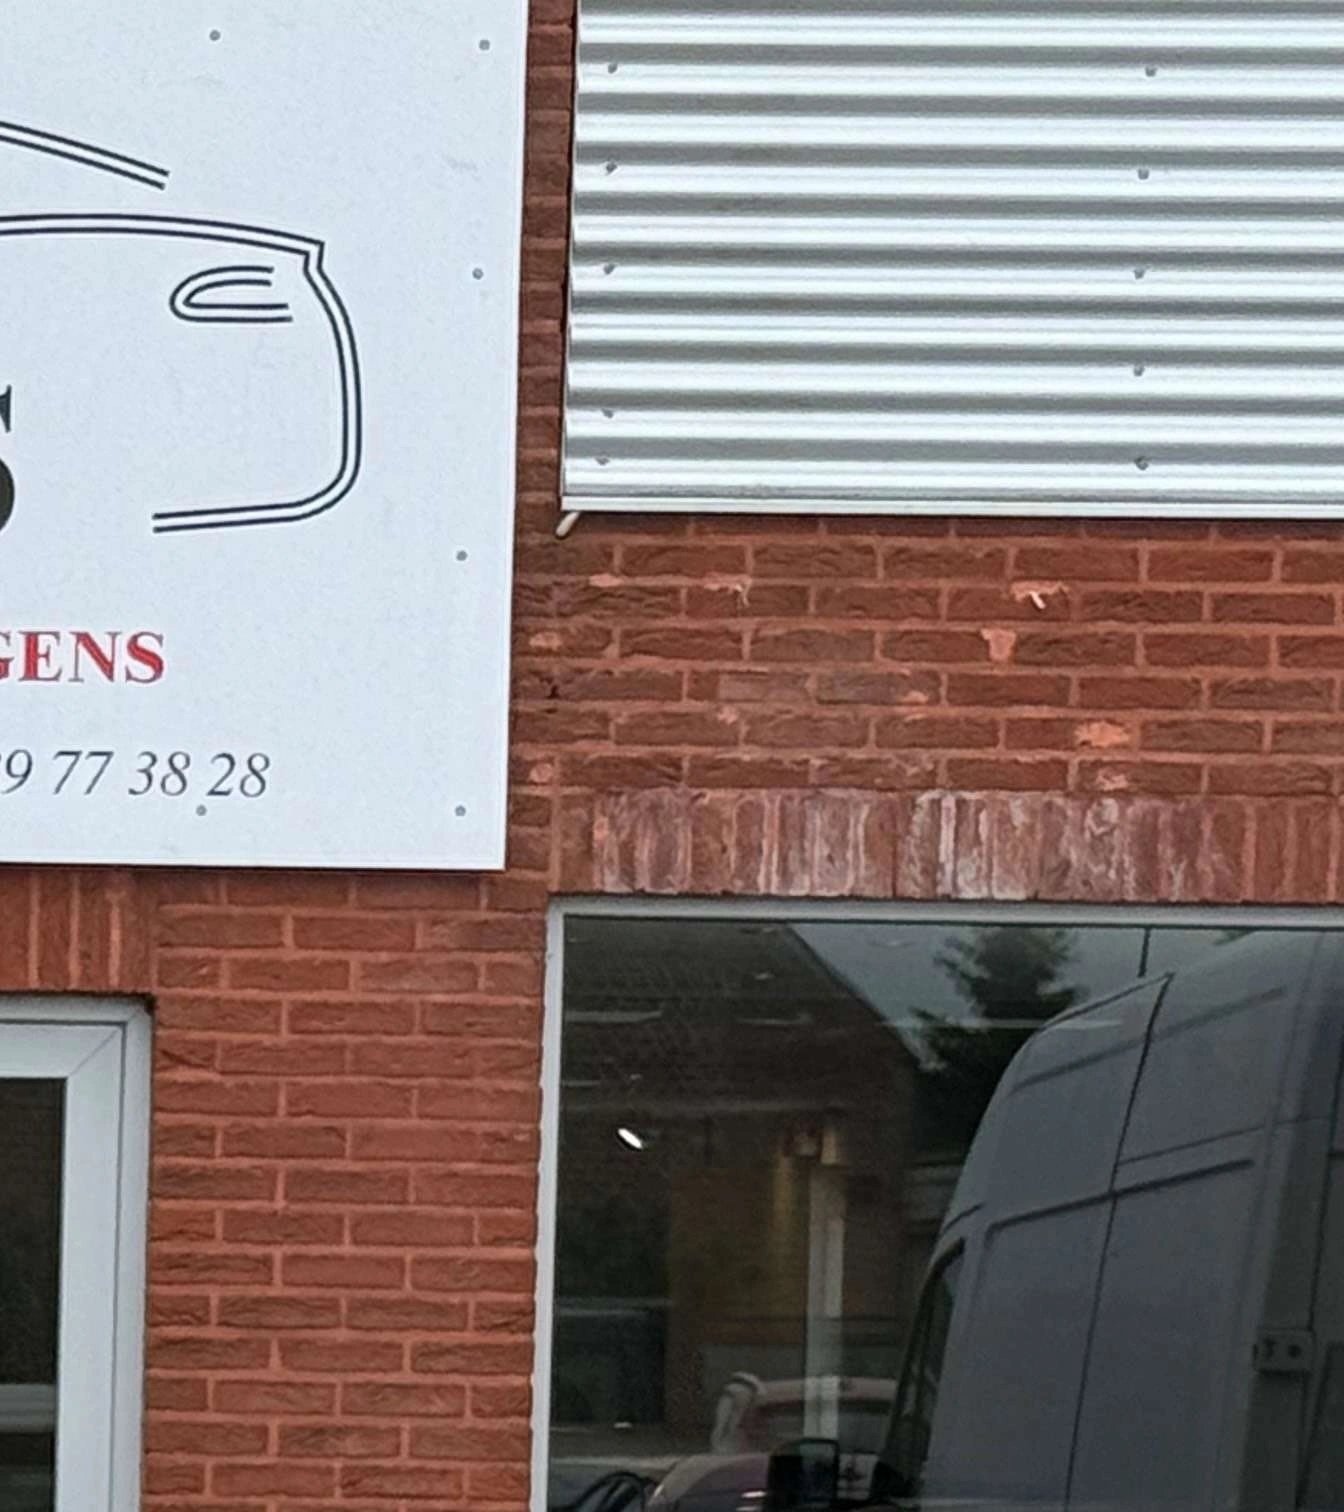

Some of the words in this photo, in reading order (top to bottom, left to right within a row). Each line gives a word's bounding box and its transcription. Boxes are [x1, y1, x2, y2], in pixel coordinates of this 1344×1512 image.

[54, 750, 116, 795] 77
[127, 751, 192, 797] 38
[206, 752, 272, 798] 28
